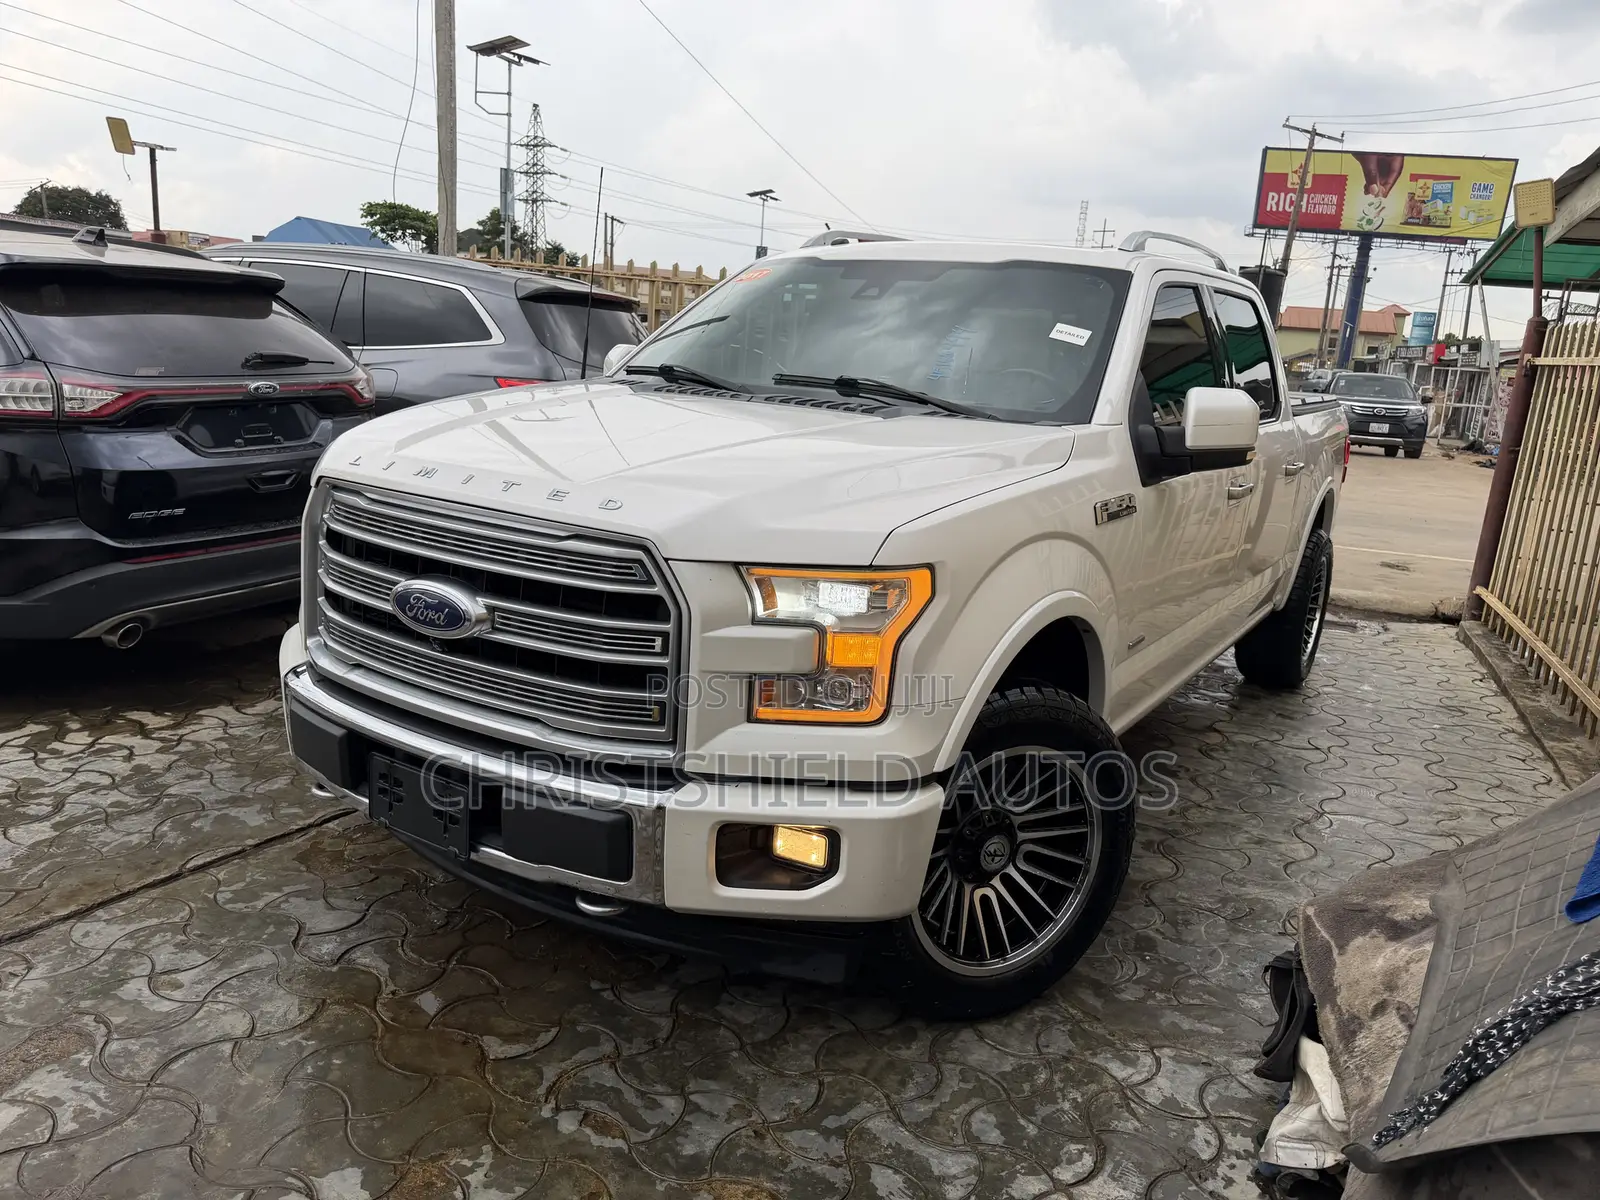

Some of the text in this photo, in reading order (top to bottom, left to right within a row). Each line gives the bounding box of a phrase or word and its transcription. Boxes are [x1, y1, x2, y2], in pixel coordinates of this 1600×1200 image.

[1309, 193, 1338, 205] CHICKEN
[1307, 203, 1337, 215] FLAVOUR
[1055, 328, 1086, 341] DETAILED
[348, 454, 624, 512] LIMITED
[127, 507, 187, 520] EDGE
[404, 592, 450, 627] Ford
